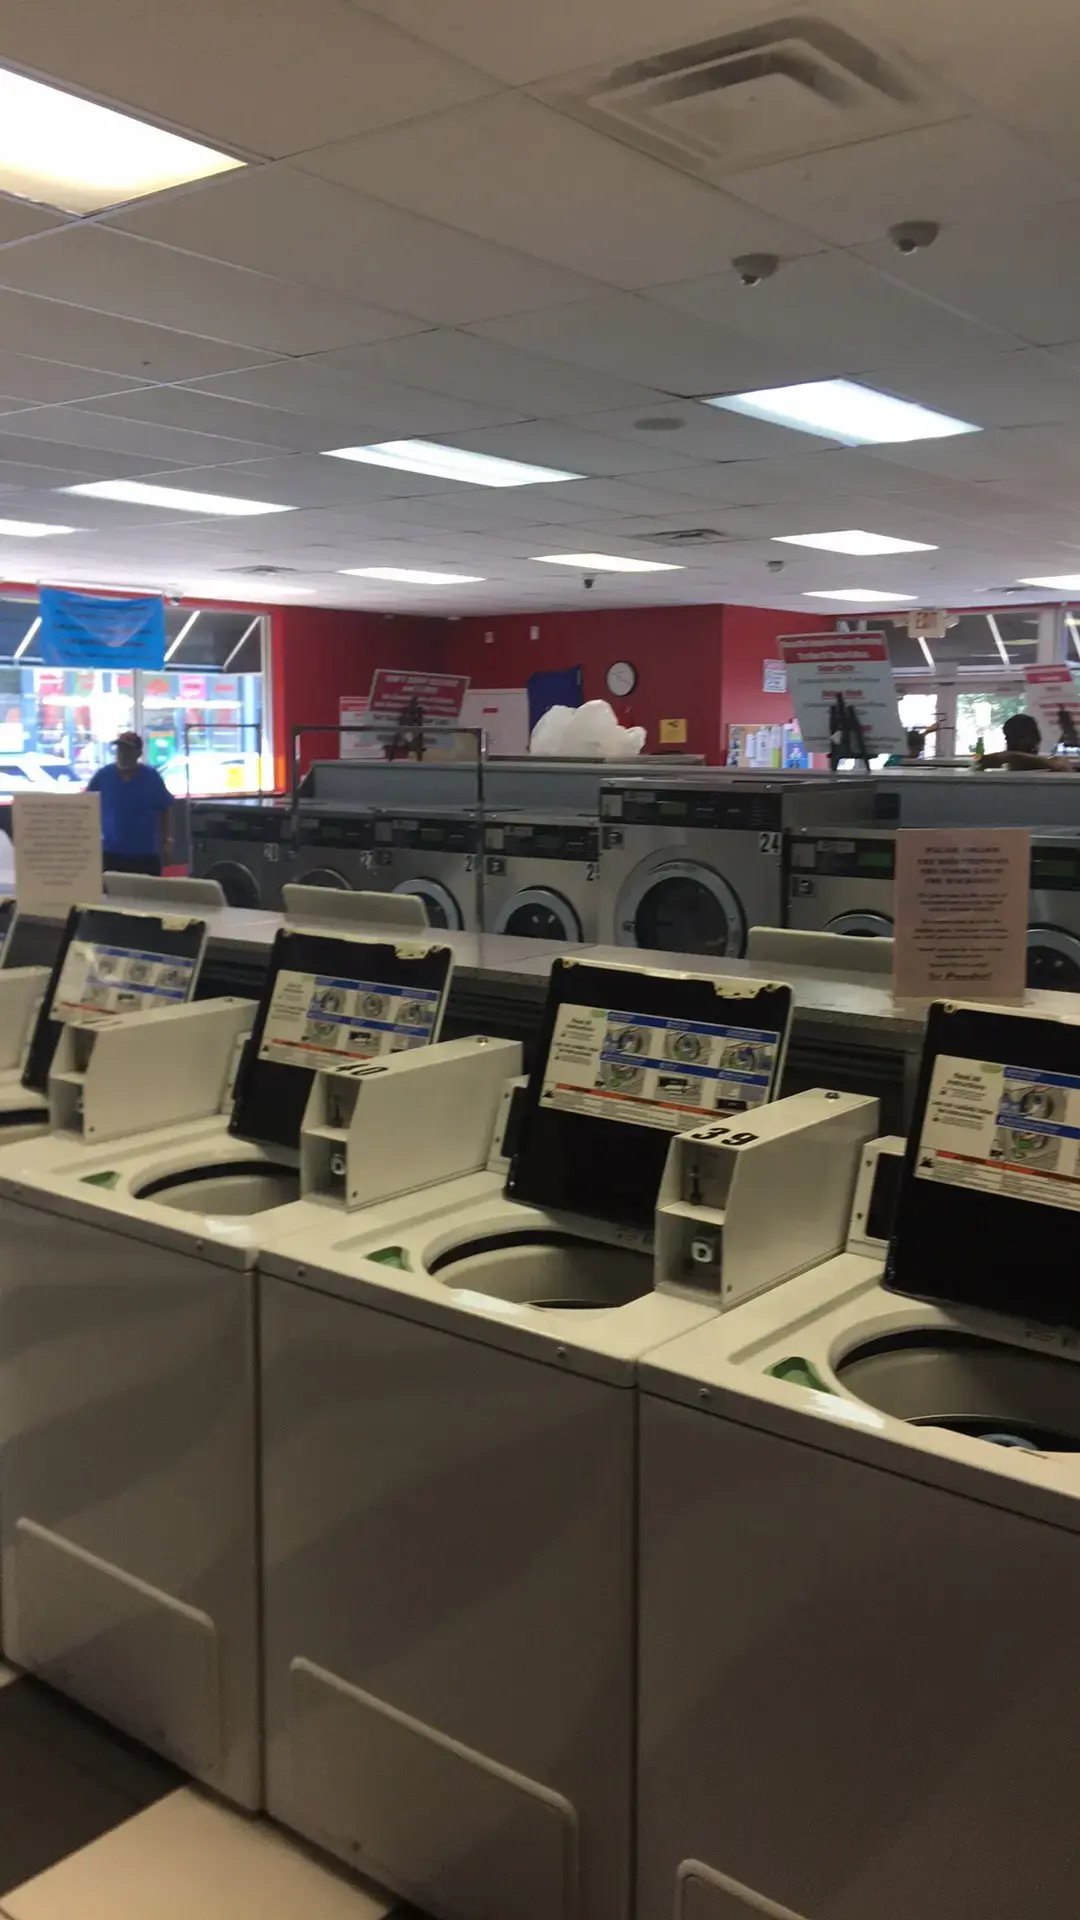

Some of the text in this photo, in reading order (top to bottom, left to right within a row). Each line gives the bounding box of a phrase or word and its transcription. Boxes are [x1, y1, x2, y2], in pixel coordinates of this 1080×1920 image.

[759, 833, 780, 853] 24
[336, 1063, 388, 1076] 40
[691, 1127, 760, 1146] 39
